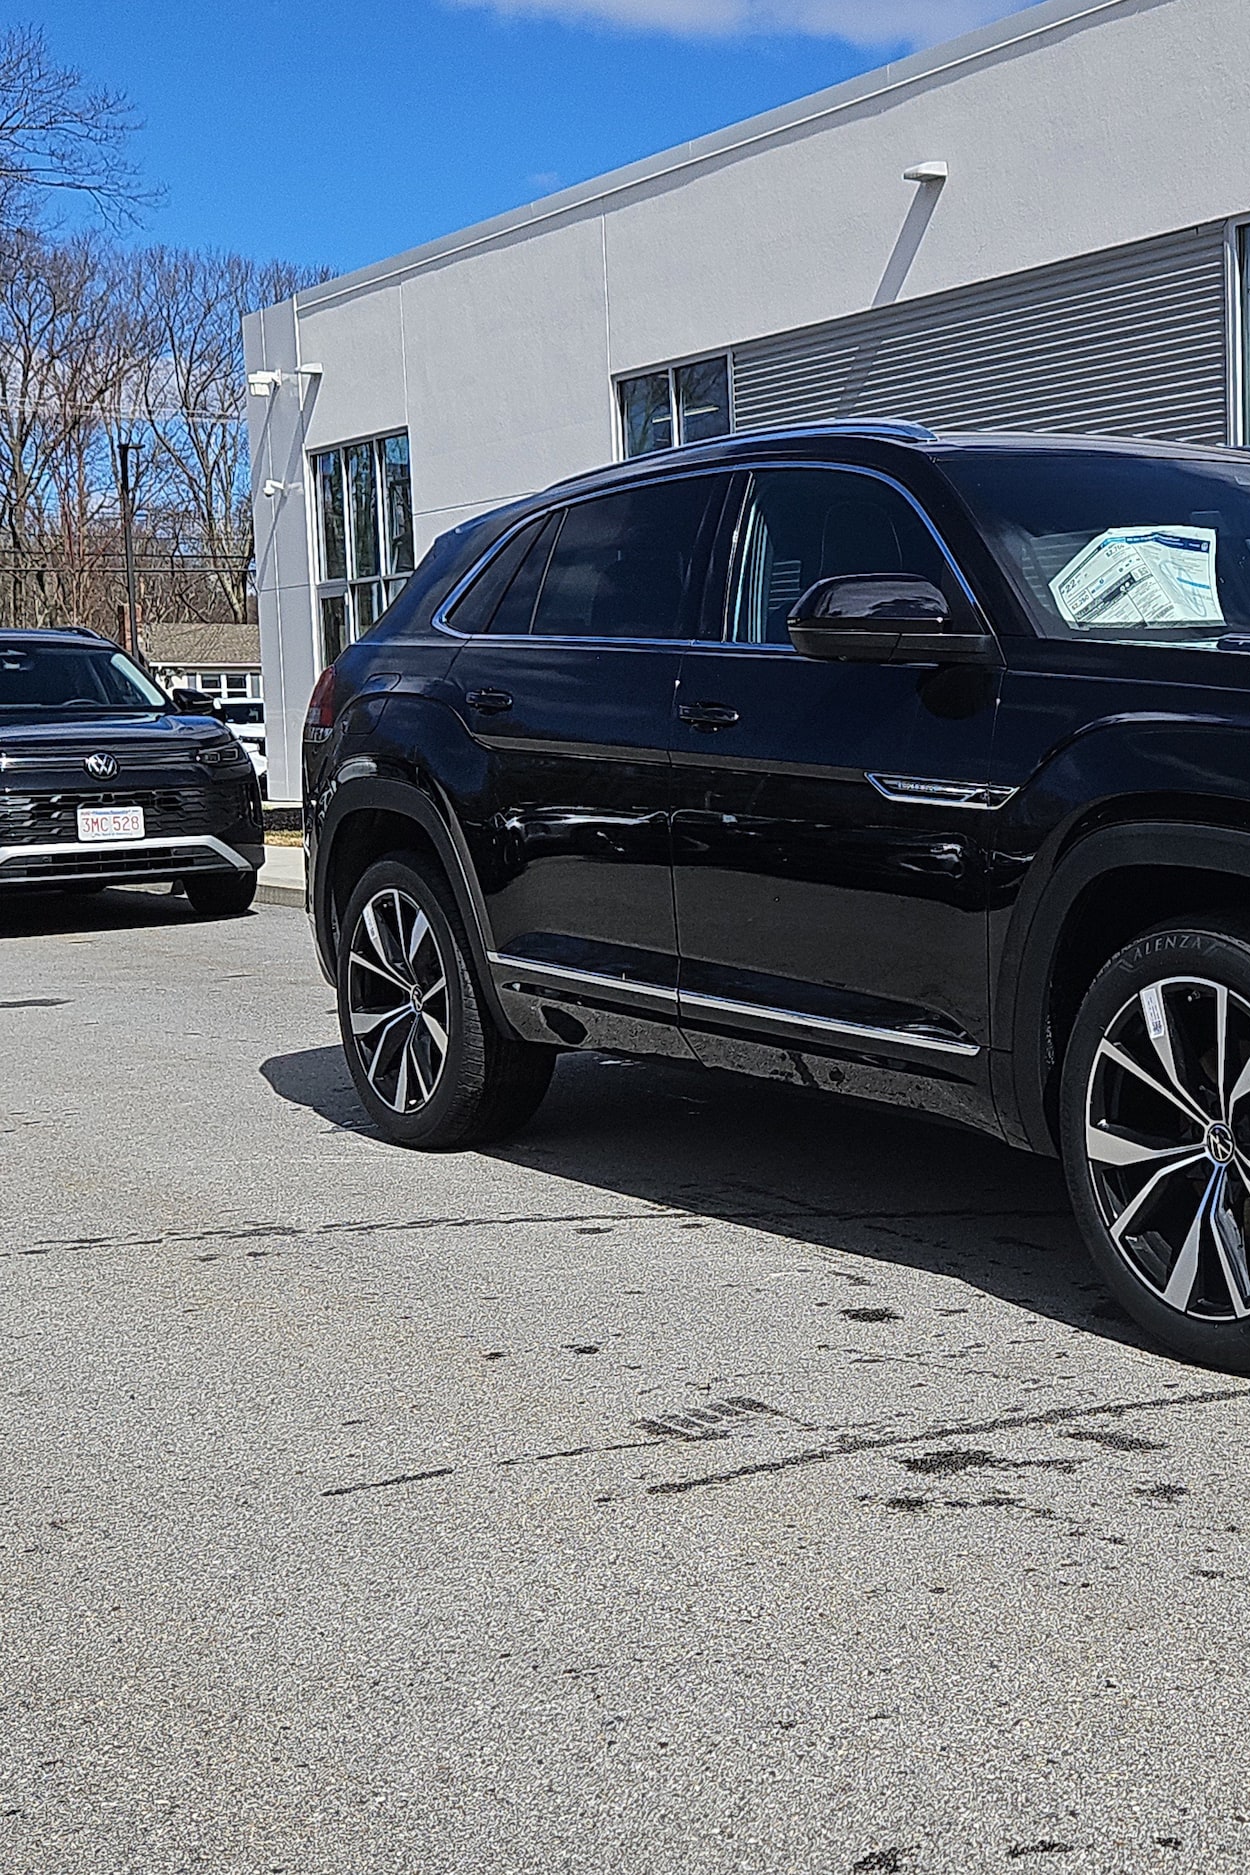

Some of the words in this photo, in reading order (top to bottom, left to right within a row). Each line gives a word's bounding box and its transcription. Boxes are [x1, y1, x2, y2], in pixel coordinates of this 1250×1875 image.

[86, 752, 118, 779] VW
[81, 816, 109, 833] 3MC
[112, 815, 140, 832] 528
[1134, 935, 1201, 962] ALENZA
